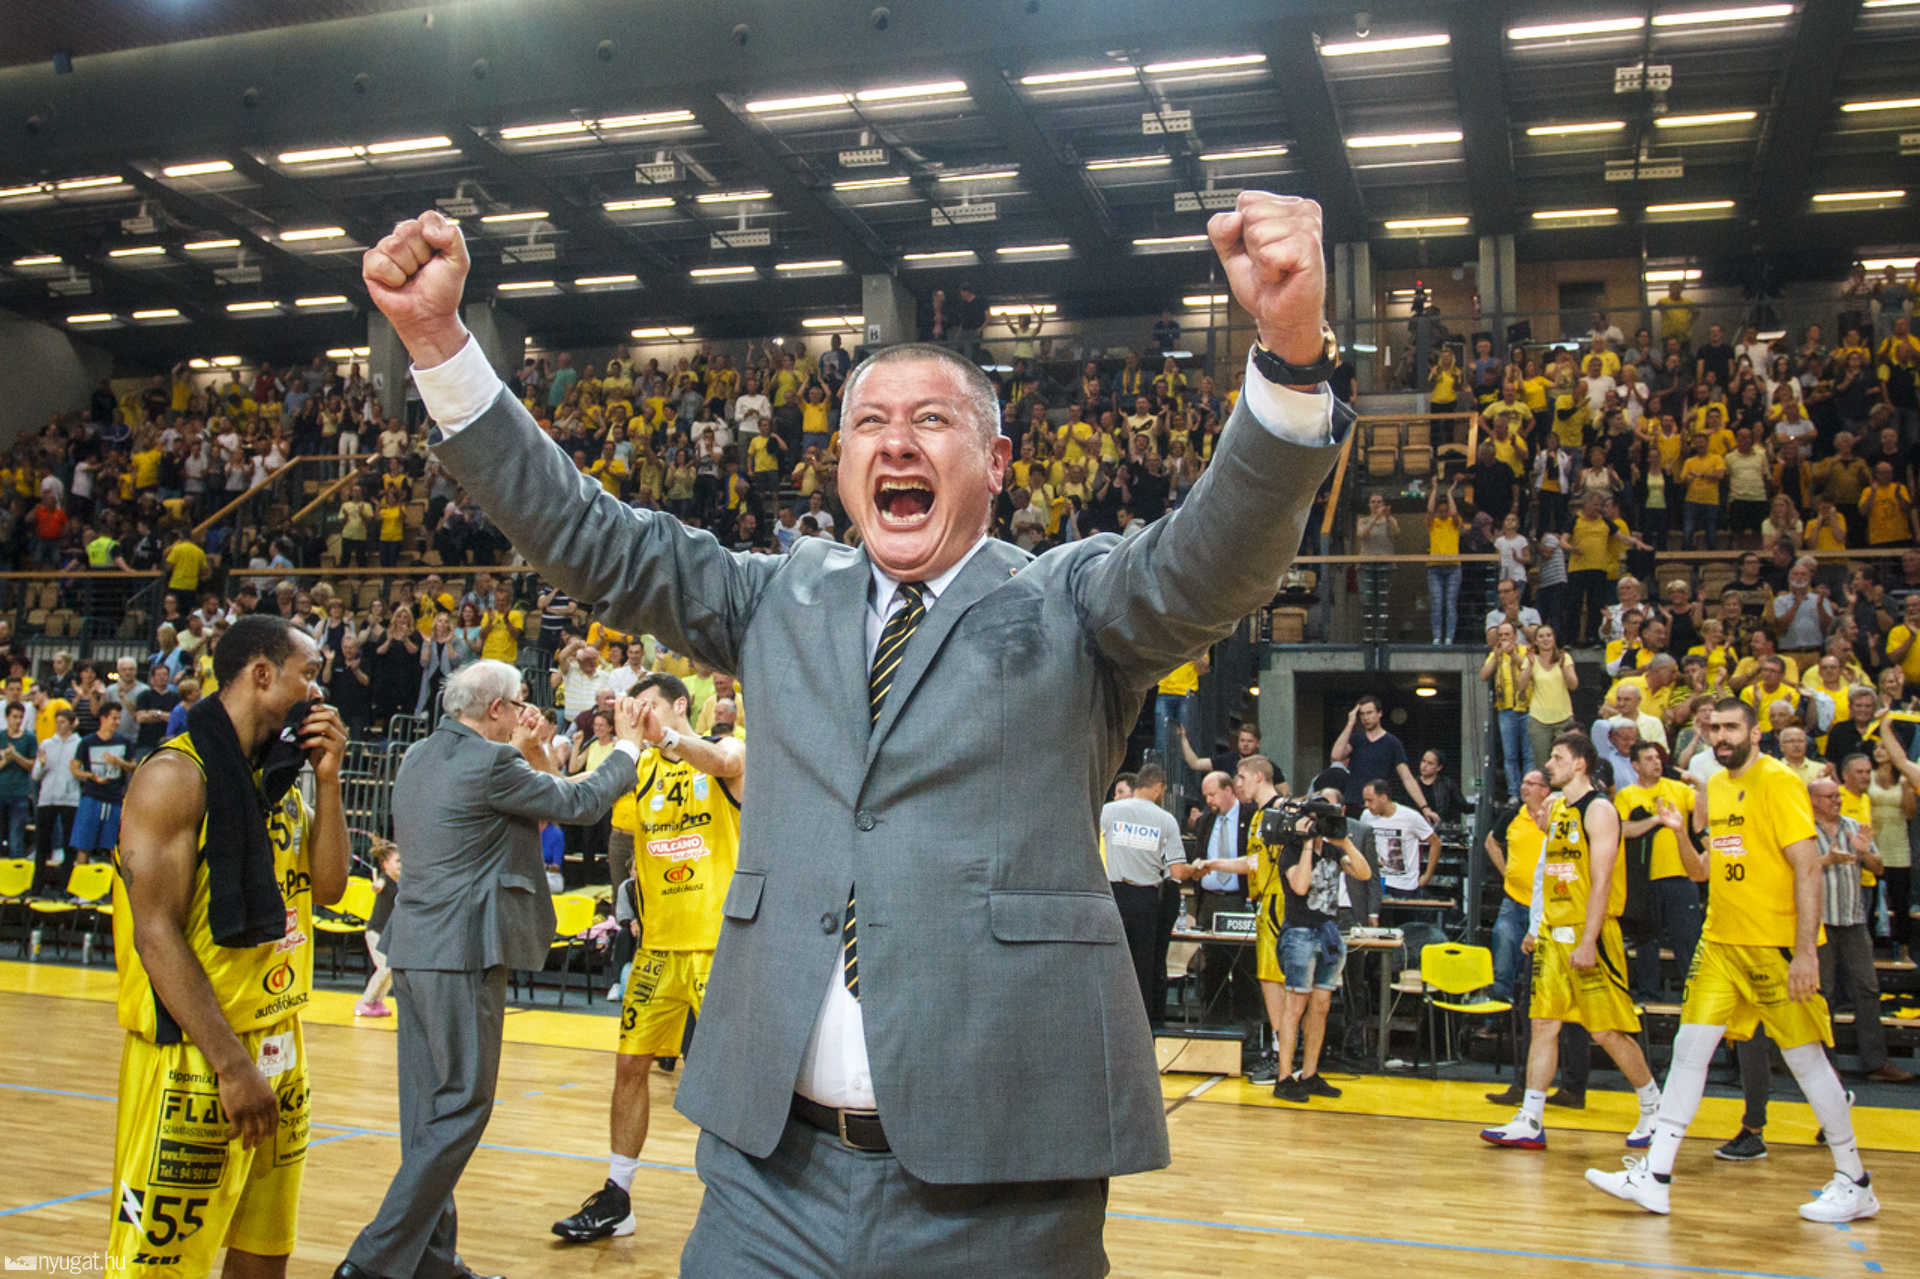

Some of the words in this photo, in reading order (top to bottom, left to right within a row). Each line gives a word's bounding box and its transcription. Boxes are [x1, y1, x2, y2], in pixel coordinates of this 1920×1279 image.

[1113, 823, 1159, 838] UNION
[1725, 863, 1745, 882] 30
[146, 1195, 209, 1248] 55
